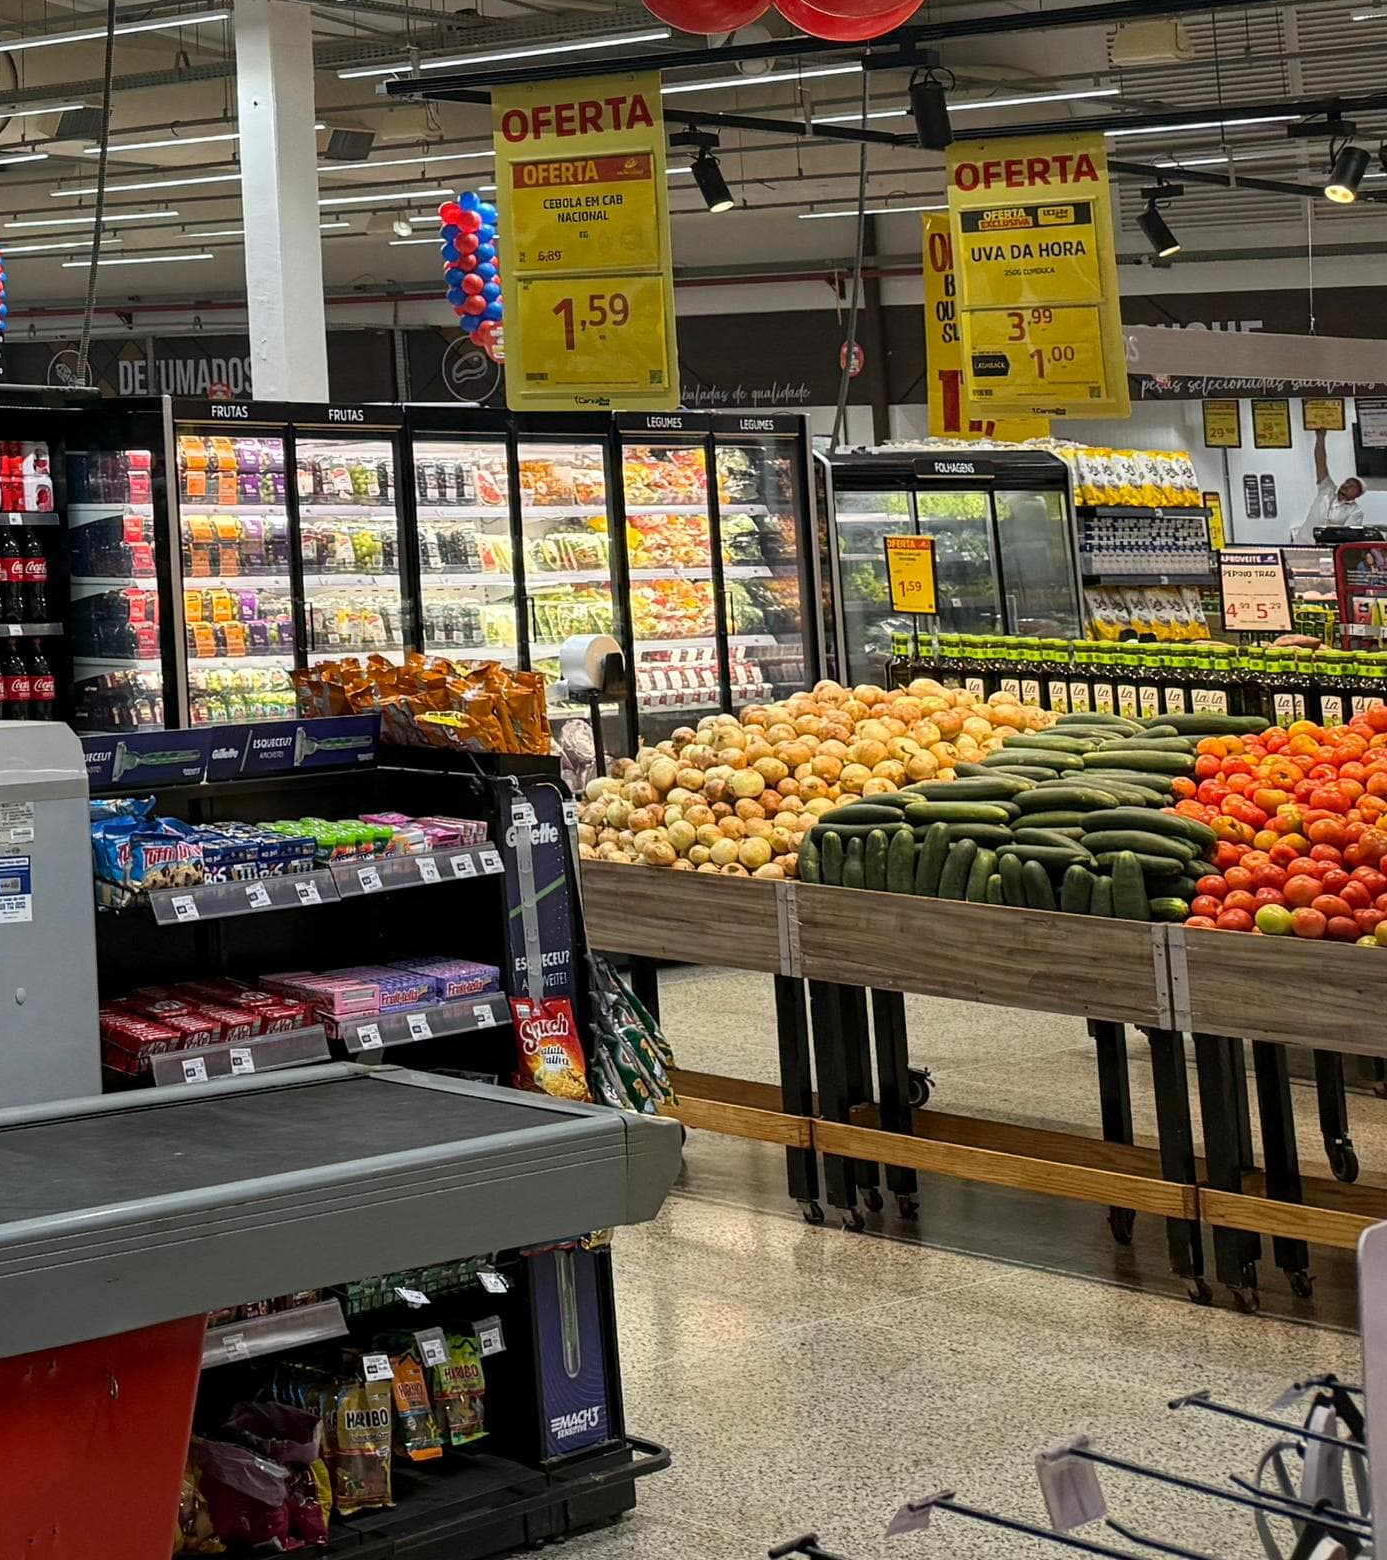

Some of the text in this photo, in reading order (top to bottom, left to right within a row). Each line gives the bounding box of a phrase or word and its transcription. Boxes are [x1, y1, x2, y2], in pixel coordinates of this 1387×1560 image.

[502, 94, 654, 143] OFERTA
[523, 161, 599, 185] OFERTA
[955, 154, 1099, 191] OFERTA
[544, 195, 623, 209] CEBOLA EM CAB
[558, 211, 608, 223] NACIONAL
[984, 209, 1026, 220] OFERTA
[980, 219, 1030, 228] EXCLUSIVA
[971, 241, 1086, 262] UVA DA HORA
[552, 293, 629, 350] 1,59
[1007, 309, 1052, 341] 3,99
[1030, 347, 1074, 379] 1,00
[119, 356, 253, 395] DEFUMADOS
[750, 382, 811, 407] qualidade
[212, 405, 248, 418] FRUTAS
[328, 409, 364, 422] FRUTAS
[647, 417, 682, 429] LEGUMES
[740, 419, 774, 430] LEGUMES
[935, 462, 974, 473] FOLHAGENS
[887, 539, 916, 549] OFERTA
[253, 737, 292, 749] ESQUECEU?
[212, 749, 238, 760] Gillette
[516, 950, 570, 972] ESECEU?
[444, 1365, 479, 1380] HARIBO
[346, 1409, 389, 1429] HARIBO
[559, 1406, 602, 1430] MACH3
[558, 1424, 588, 1439] SENSITIVE
